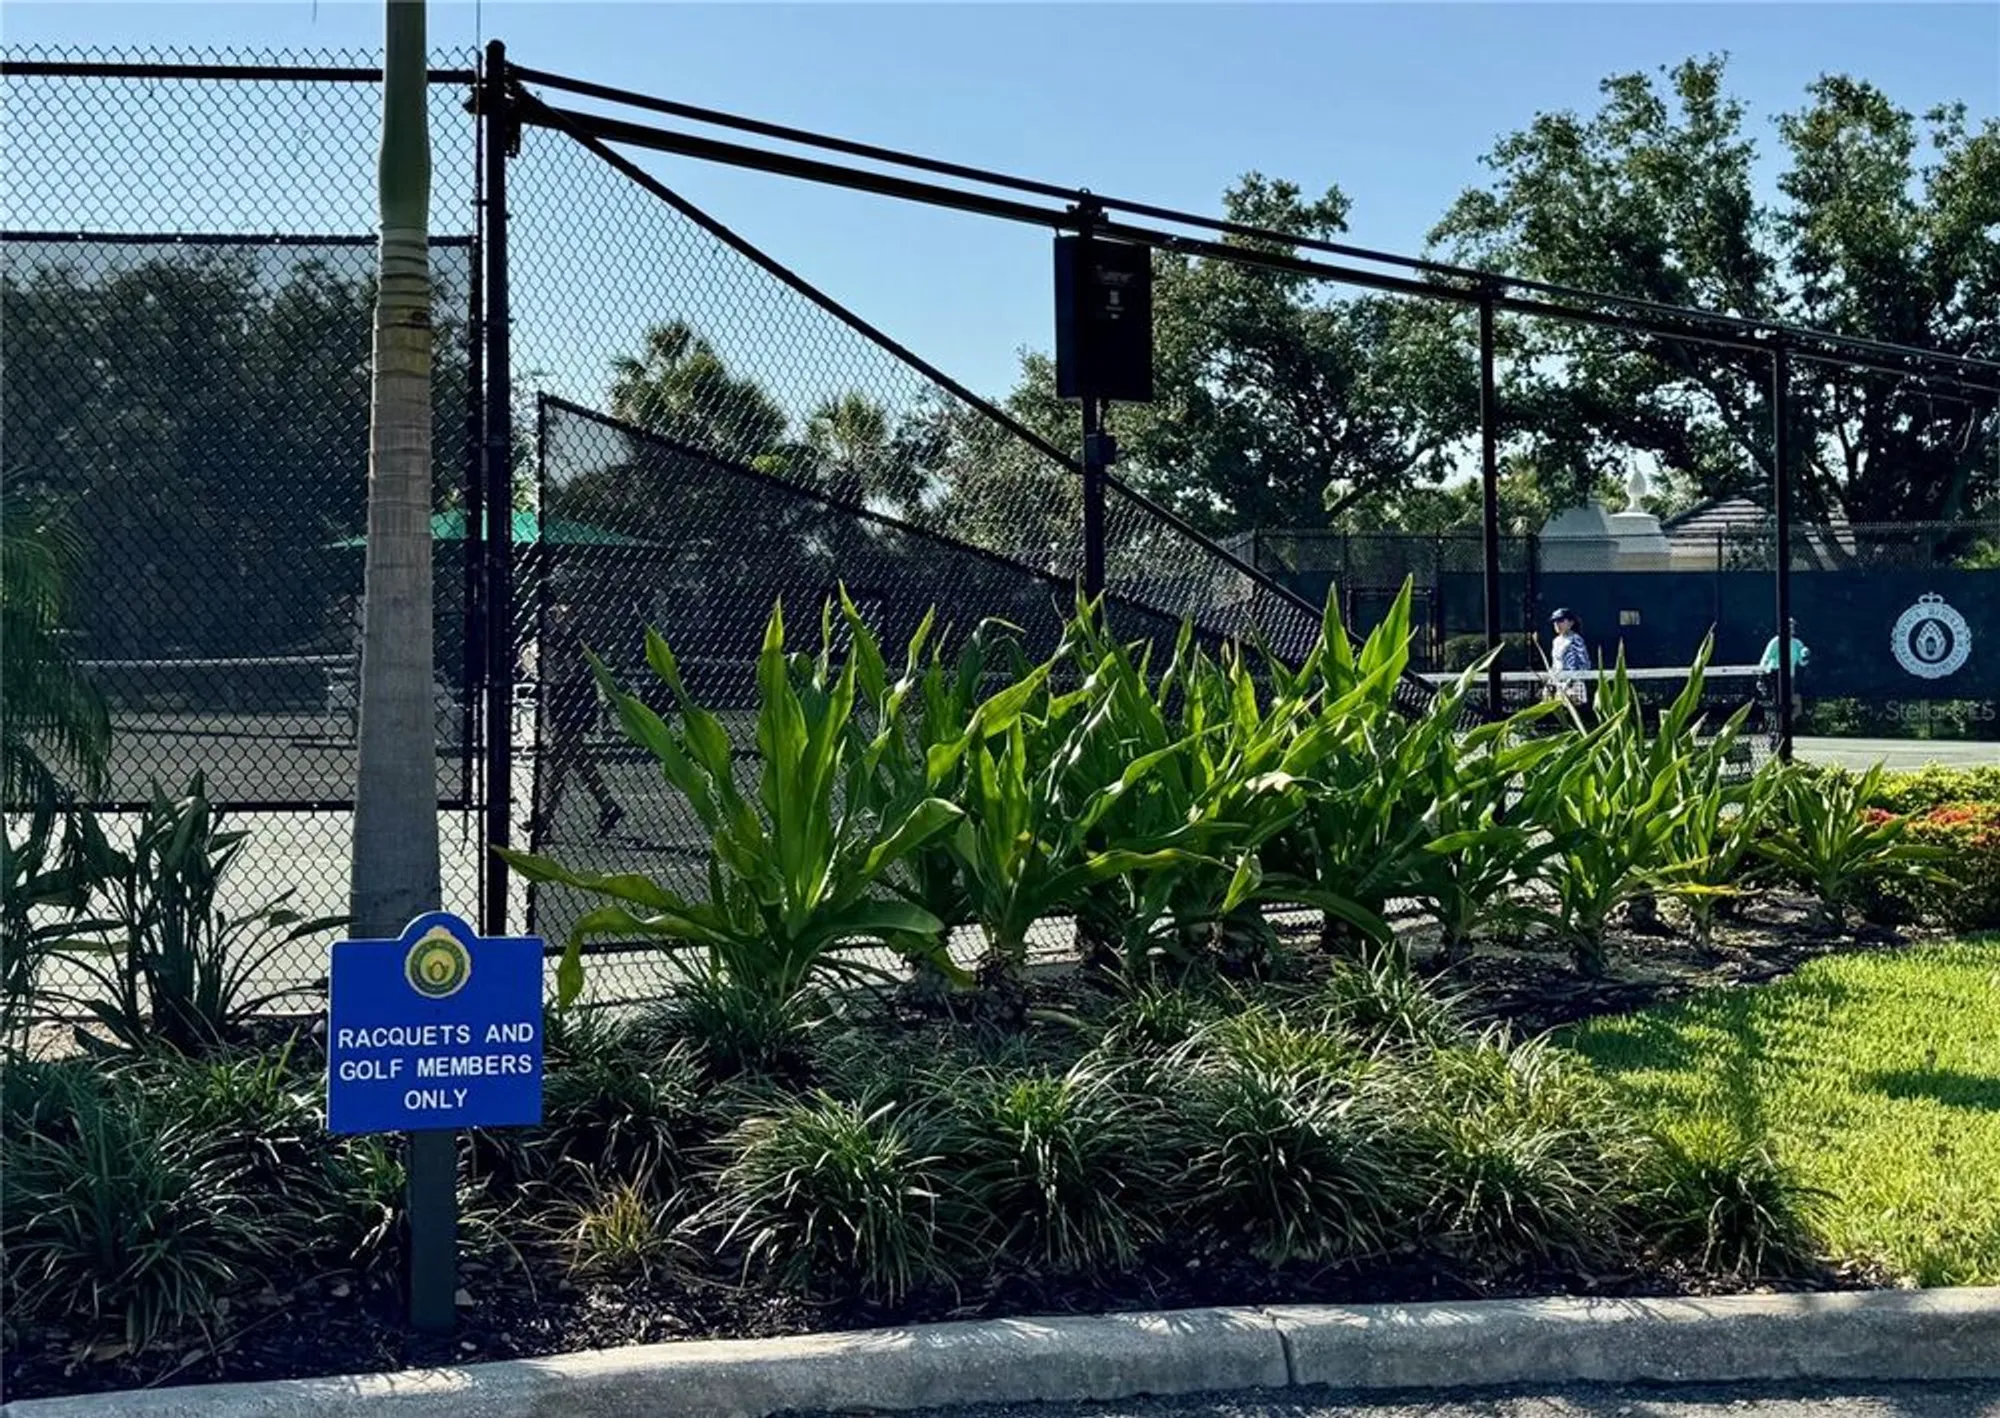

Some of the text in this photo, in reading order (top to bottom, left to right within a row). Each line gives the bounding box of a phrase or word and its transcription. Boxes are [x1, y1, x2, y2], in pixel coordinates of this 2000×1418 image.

[338, 1022, 534, 1049] RACQUETS AND
[339, 1054, 532, 1081] GOLF MEMBERS
[404, 1088, 468, 1110] ONLY
